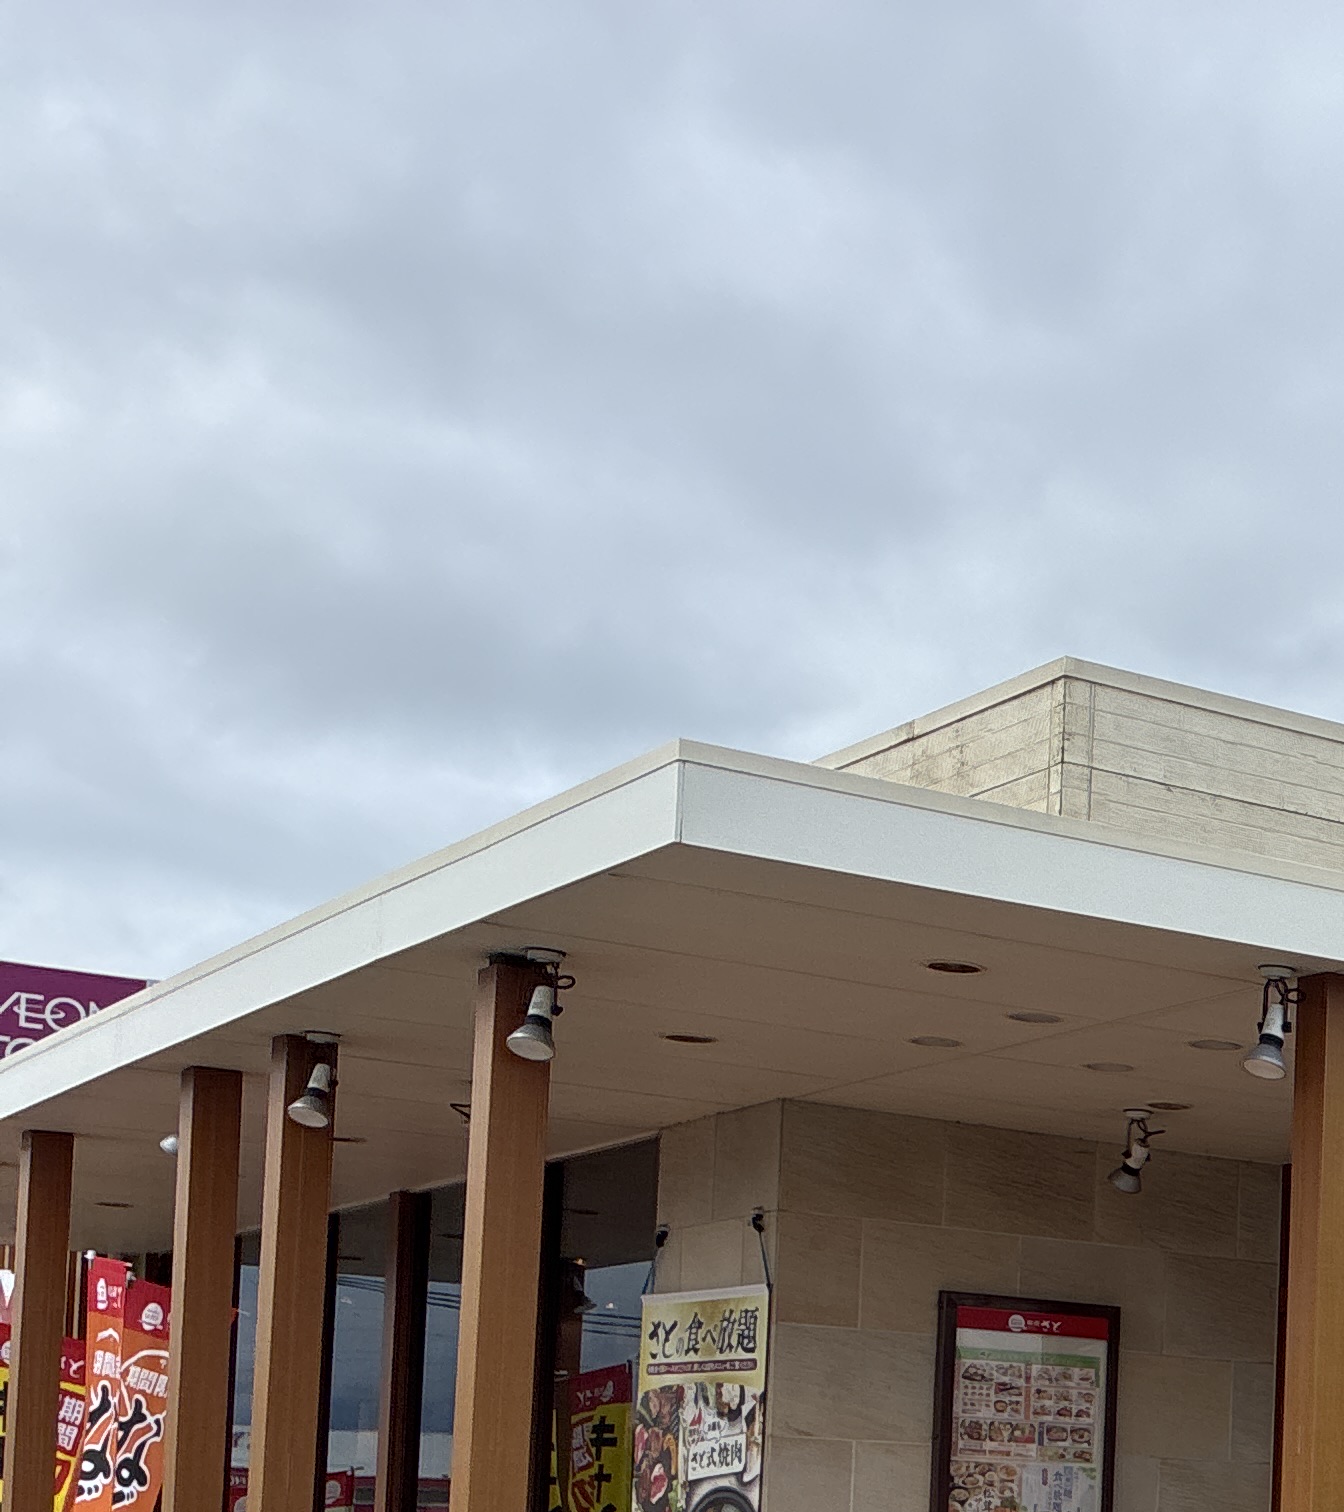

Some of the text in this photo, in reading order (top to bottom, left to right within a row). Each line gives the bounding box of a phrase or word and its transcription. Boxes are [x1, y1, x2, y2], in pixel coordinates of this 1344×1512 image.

[648, 1306, 760, 1360] さとの食べ放題
